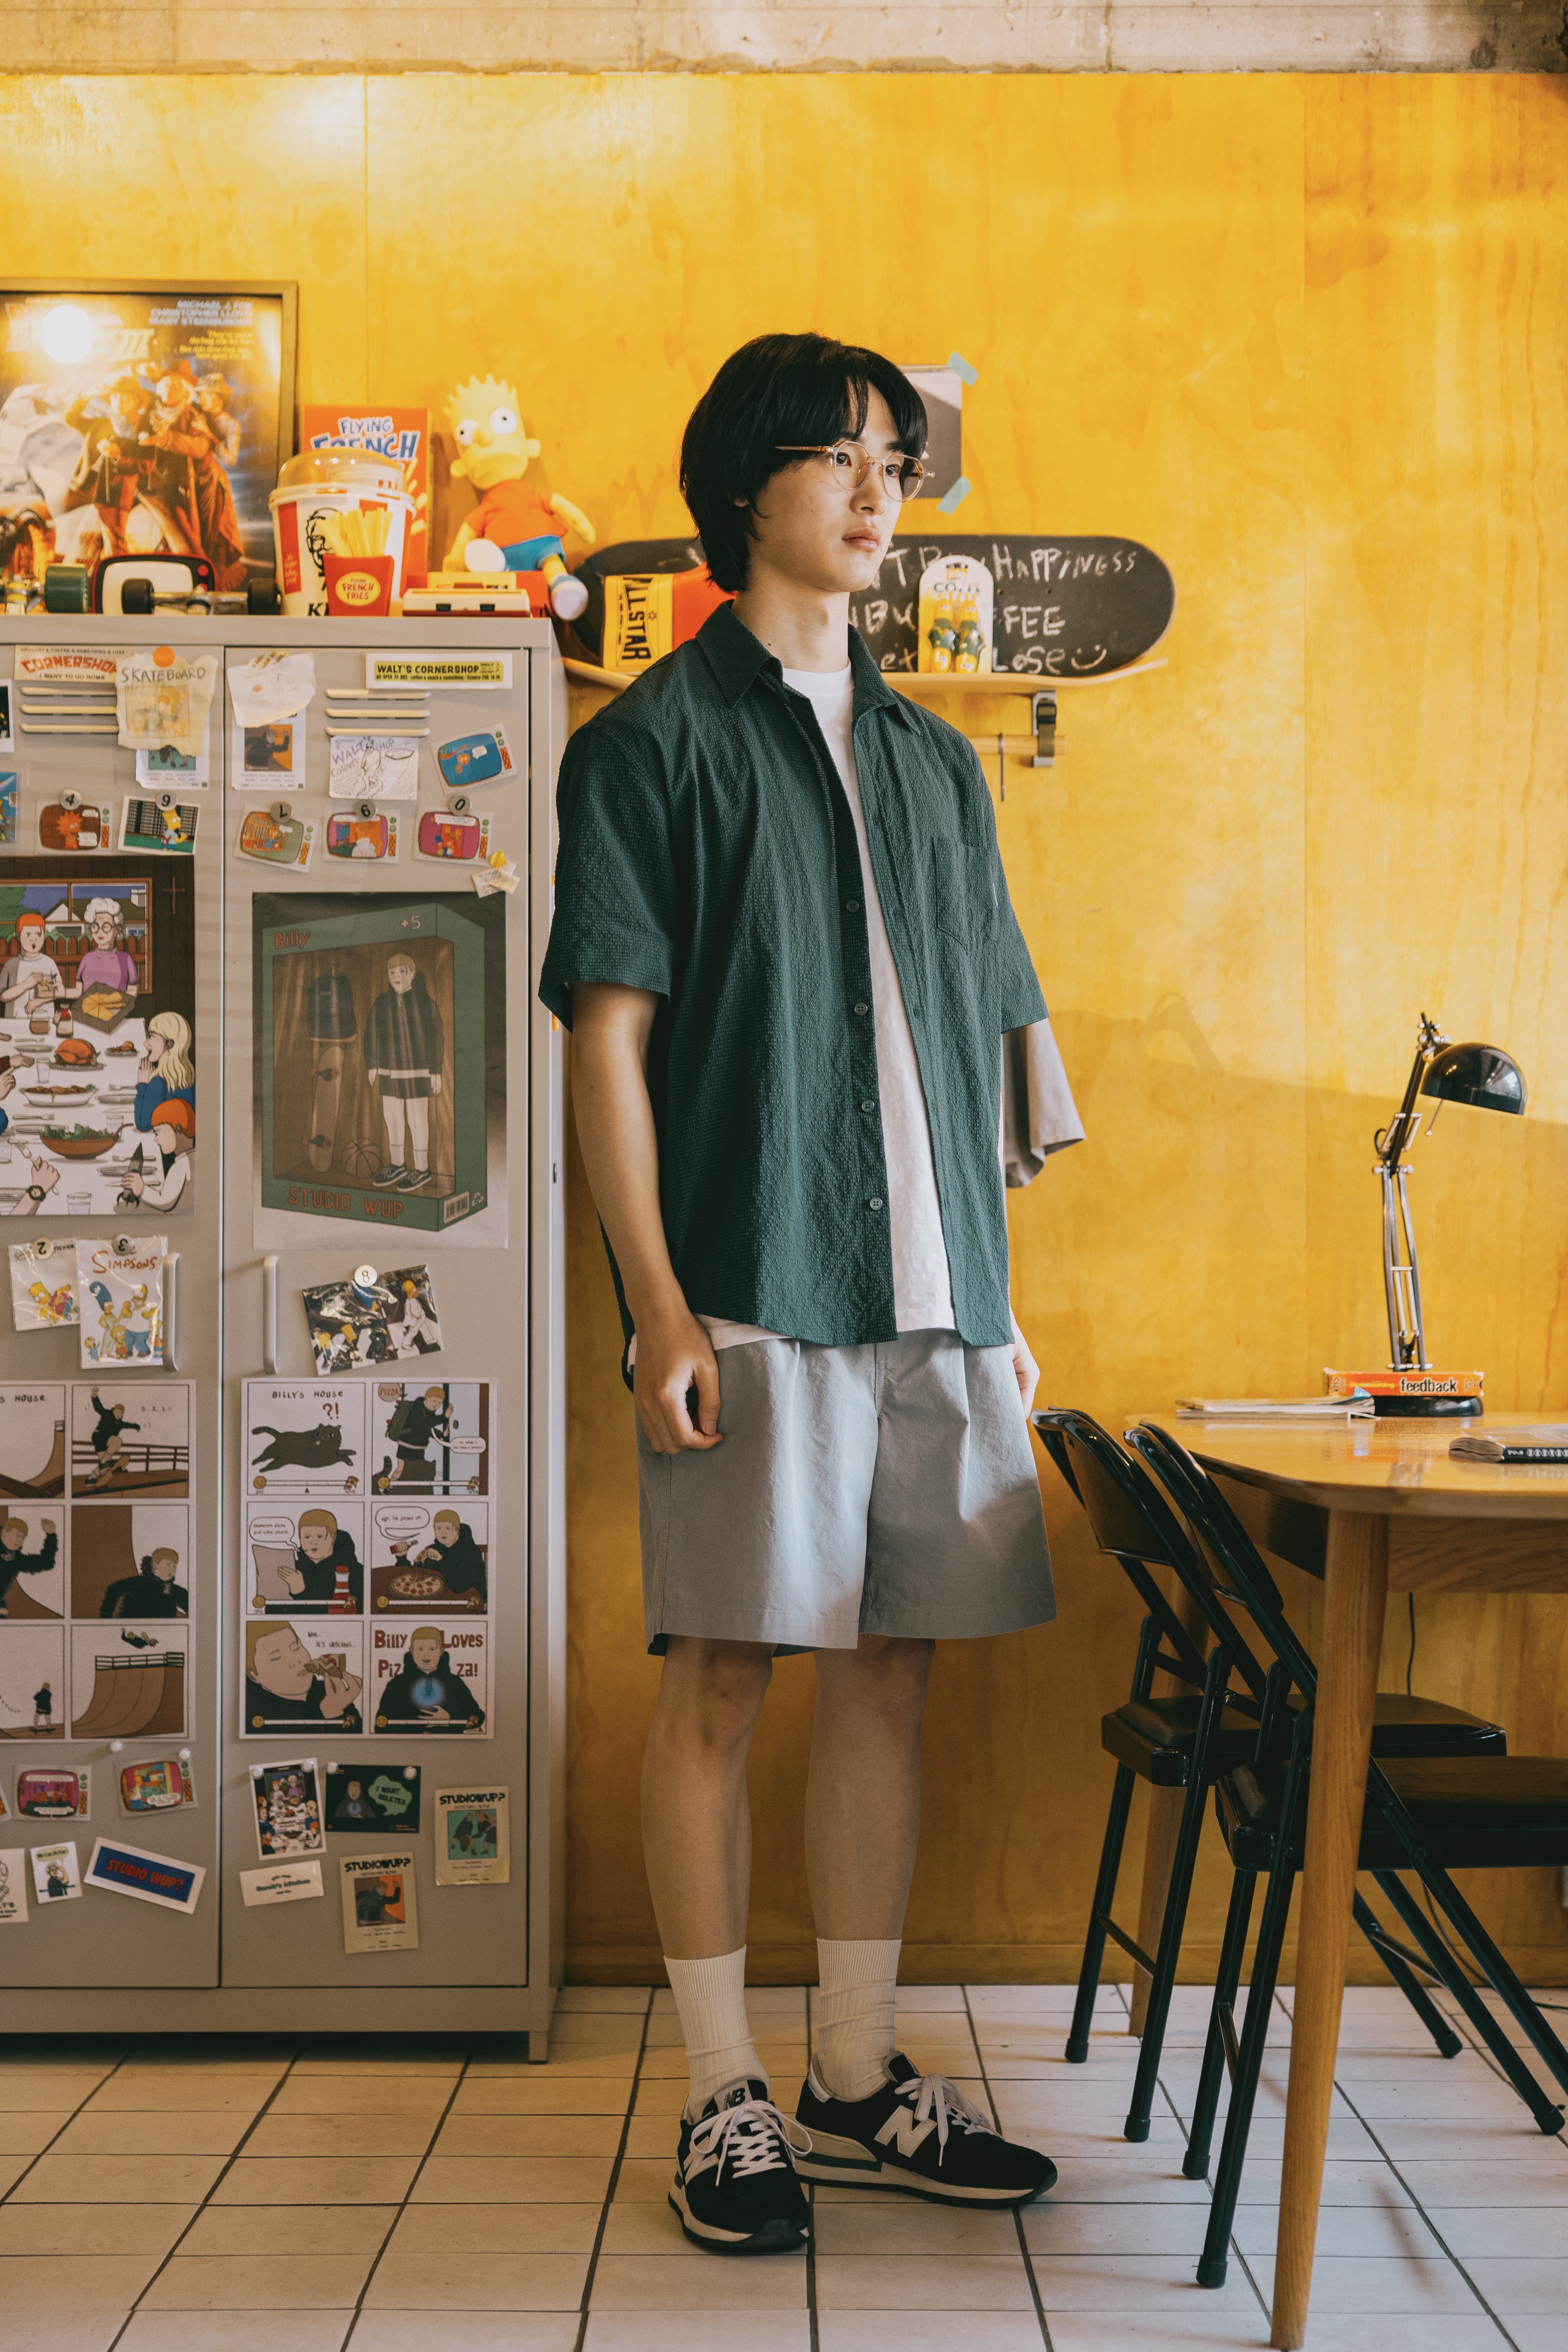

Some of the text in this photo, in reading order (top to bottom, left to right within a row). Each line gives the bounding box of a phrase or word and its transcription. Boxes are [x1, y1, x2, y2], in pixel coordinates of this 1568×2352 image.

[339, 417, 392, 434] FLYING
[342, 583, 374, 592] FRENCH
[121, 667, 206, 683] SKATEBOARD
[415, 665, 479, 674] CORNERSHOP
[65, 794, 75, 806] 4
[275, 915, 421, 949] Billy +5
[288, 1187, 404, 1219] STUDIO WUP
[37, 1241, 47, 1255] 2
[92, 1250, 157, 1274] SIMPSONS
[362, 1271, 369, 1282] 8
[1400, 1377, 1458, 1392] feedback
[272, 1391, 304, 1399] BILLY'S
[380, 1388, 399, 1396] PIZZA
[375, 1630, 483, 1649] Billy Loves
[382, 1786, 400, 1794] WANT
[106, 1859, 184, 1891] STUDIO WUP?
